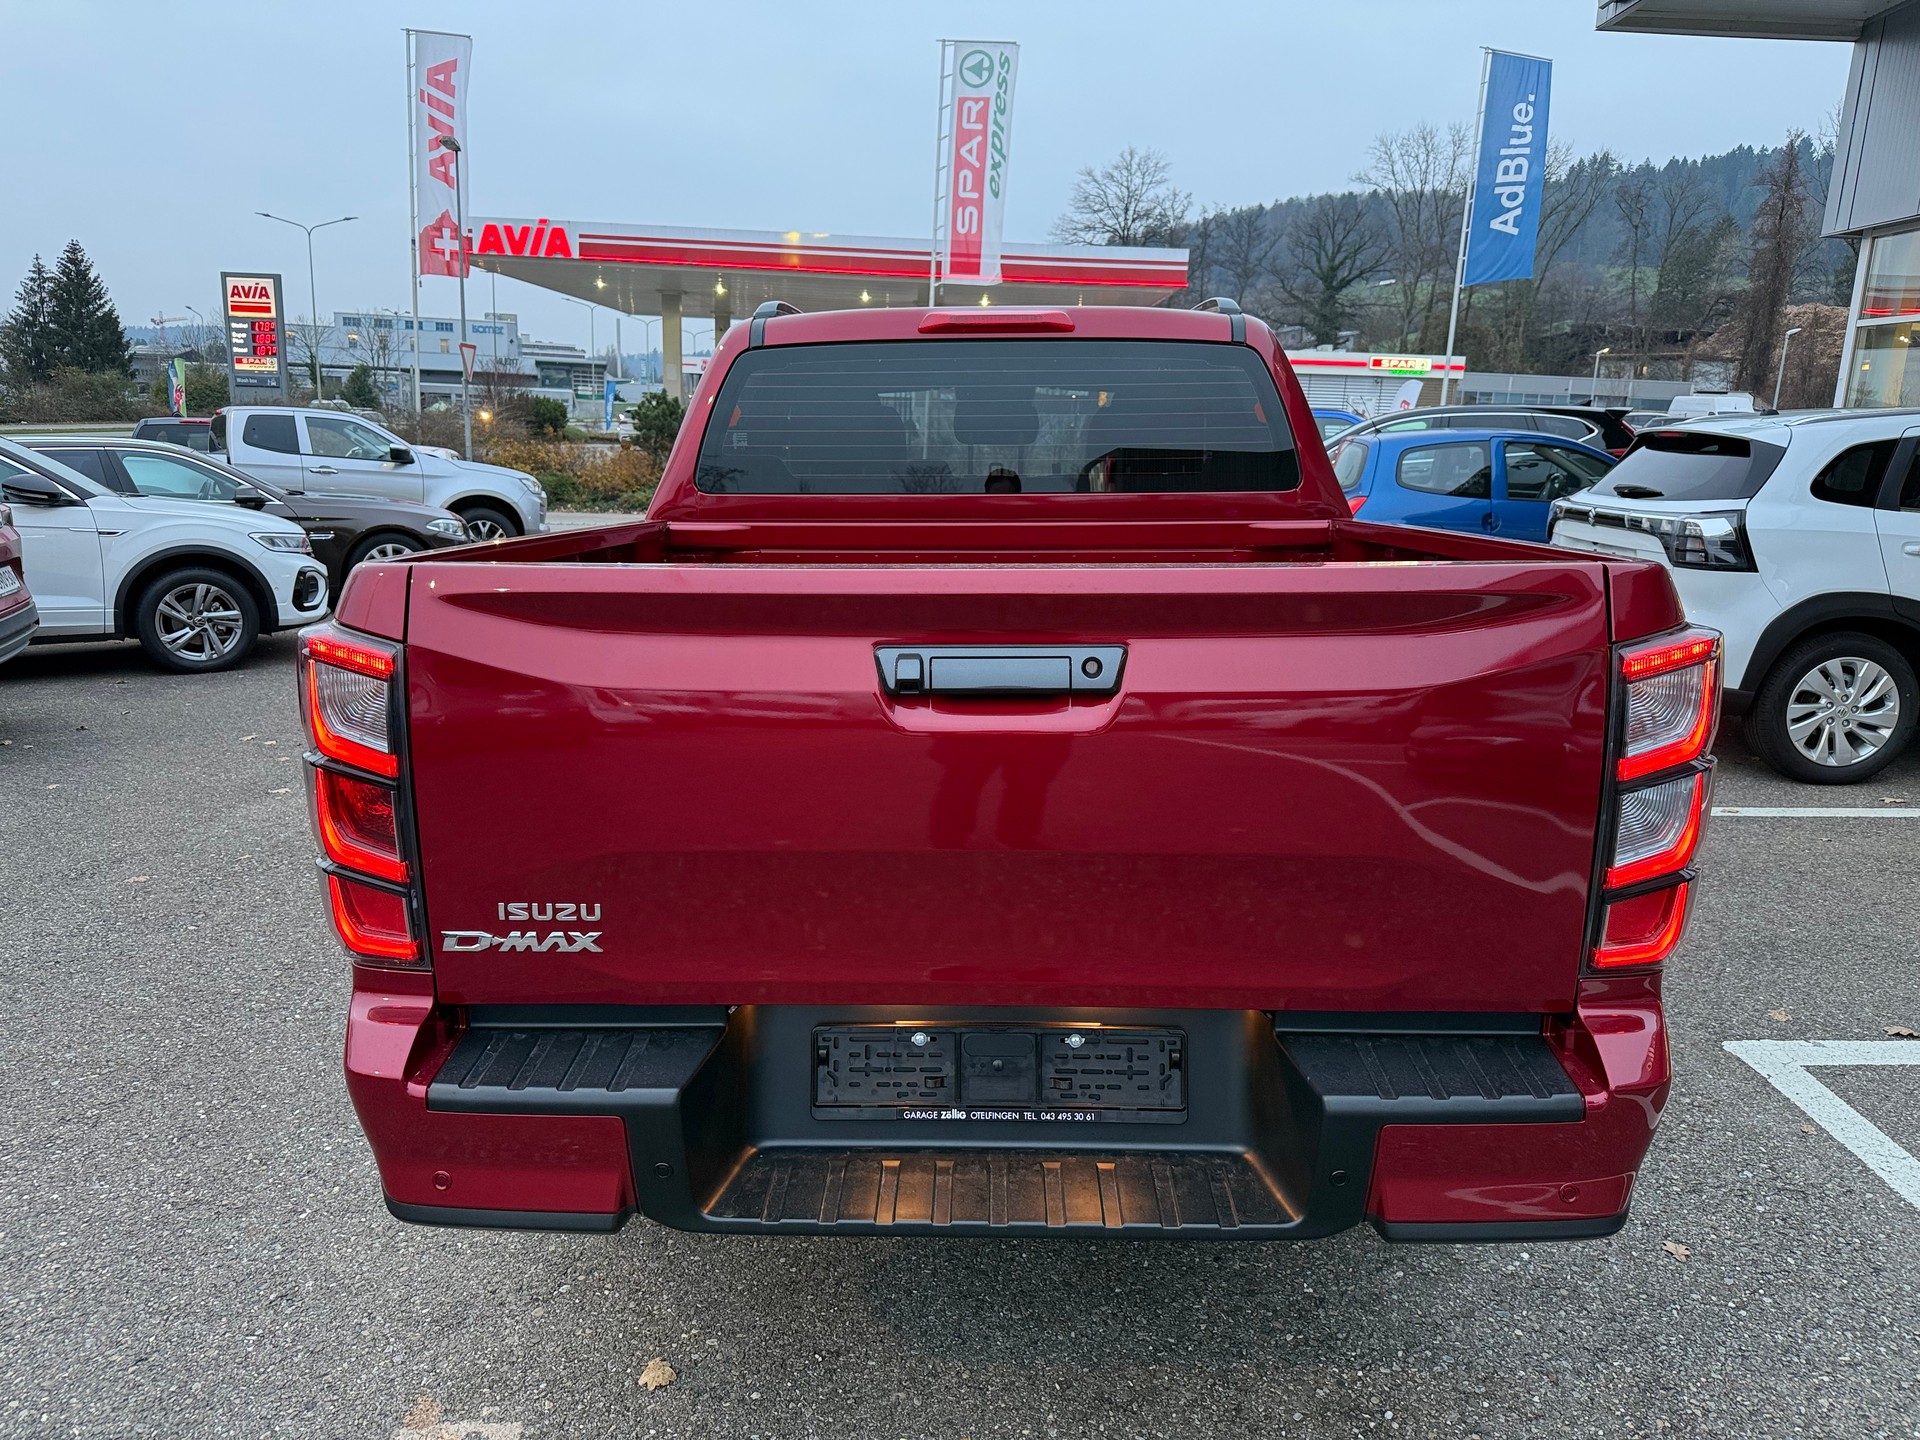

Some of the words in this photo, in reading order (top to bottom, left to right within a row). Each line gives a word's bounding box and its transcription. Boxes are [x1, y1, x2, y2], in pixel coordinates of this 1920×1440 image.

[419, 57, 458, 190] AVIA
[988, 50, 1011, 200] express
[956, 99, 985, 235] SPAR
[476, 218, 573, 258] AVIA
[230, 282, 271, 300] AVIA
[1381, 359, 1416, 368] SPAR
[497, 902, 602, 922] ISUZU
[903, 1111, 938, 1120] GARAGE
[970, 1111, 1019, 1121] OTELFINGEN
[1041, 1112, 1055, 1122] 043
[1058, 1112, 1073, 1122] 495
[1074, 1112, 1084, 1122] 30
[1086, 1113, 1095, 1122] 61
